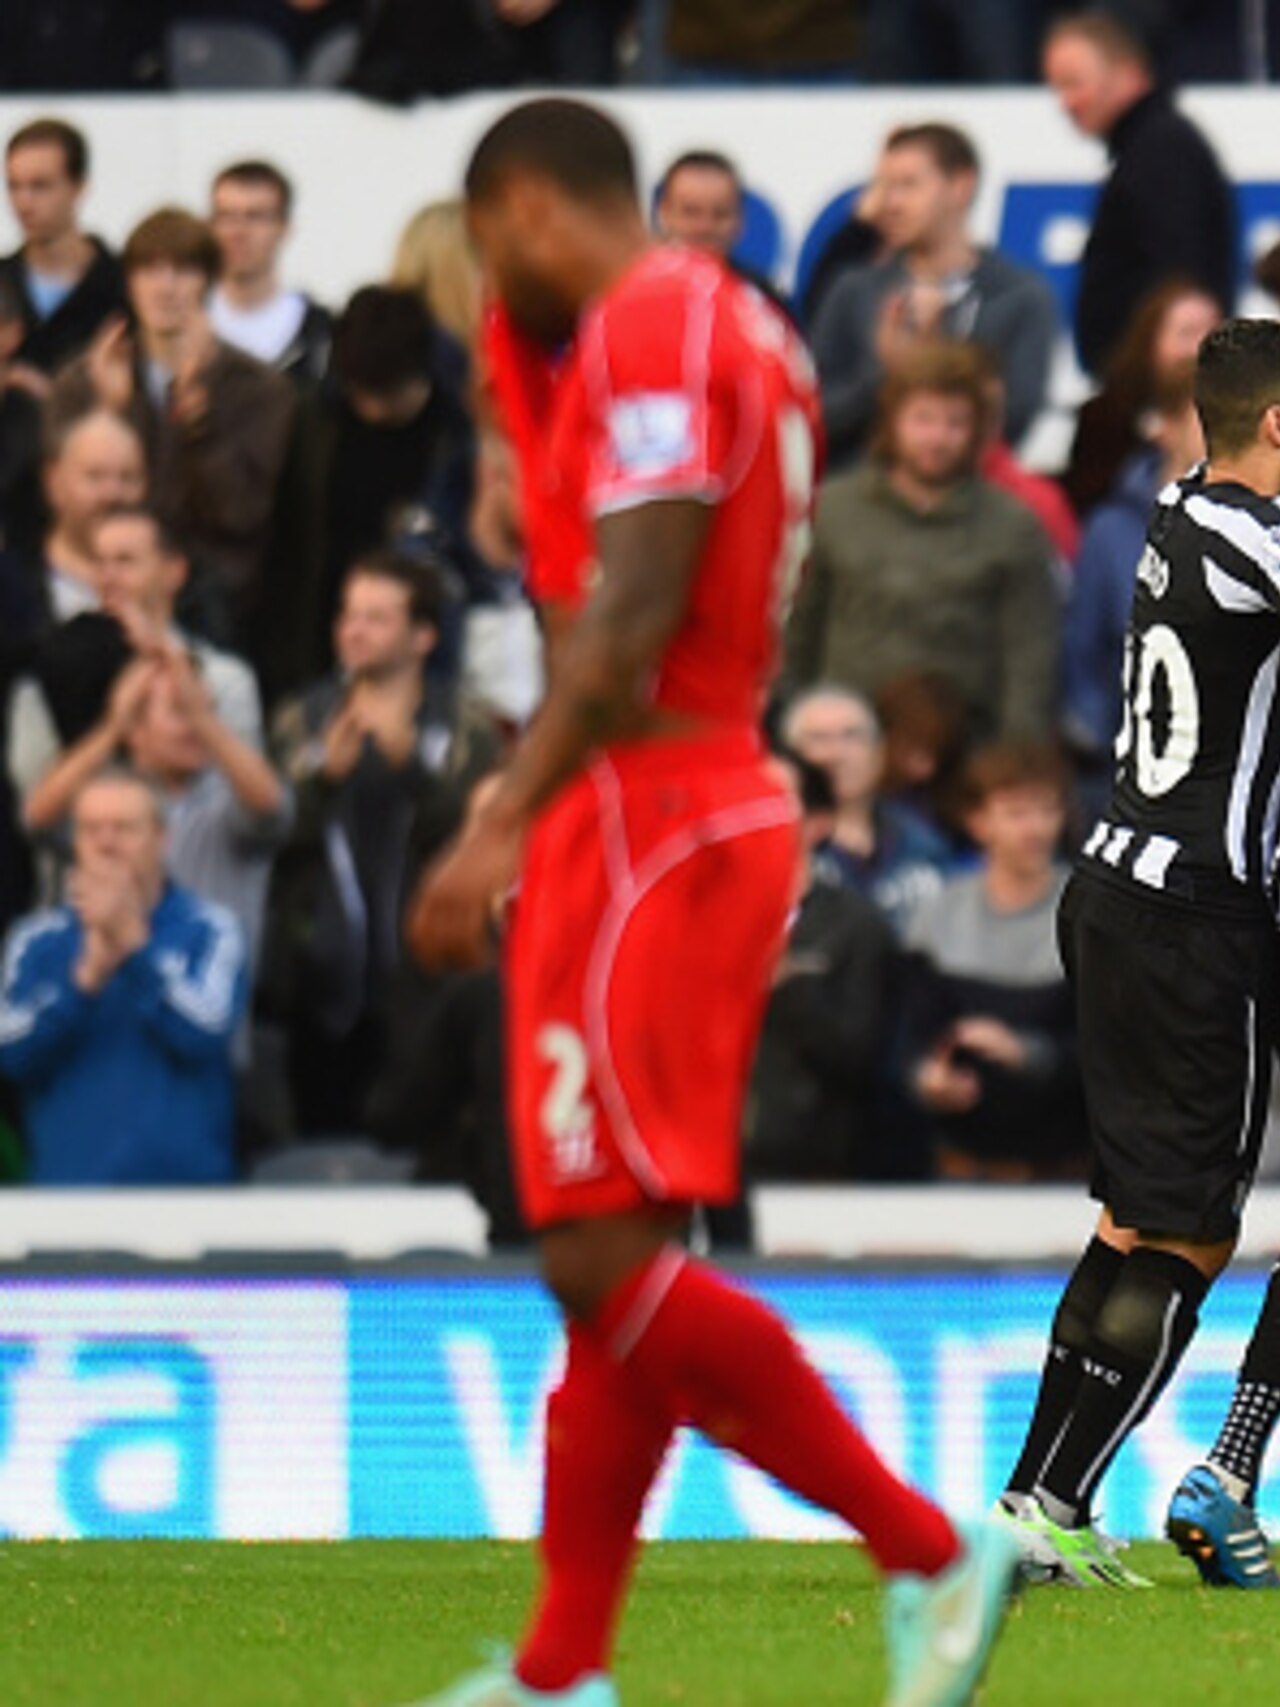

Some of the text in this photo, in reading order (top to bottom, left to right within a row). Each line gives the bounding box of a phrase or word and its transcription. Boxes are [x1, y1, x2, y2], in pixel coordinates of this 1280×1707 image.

[1115, 624, 1199, 798] 0
[536, 1022, 596, 1142] 2
[0, 1332, 217, 1538] a
